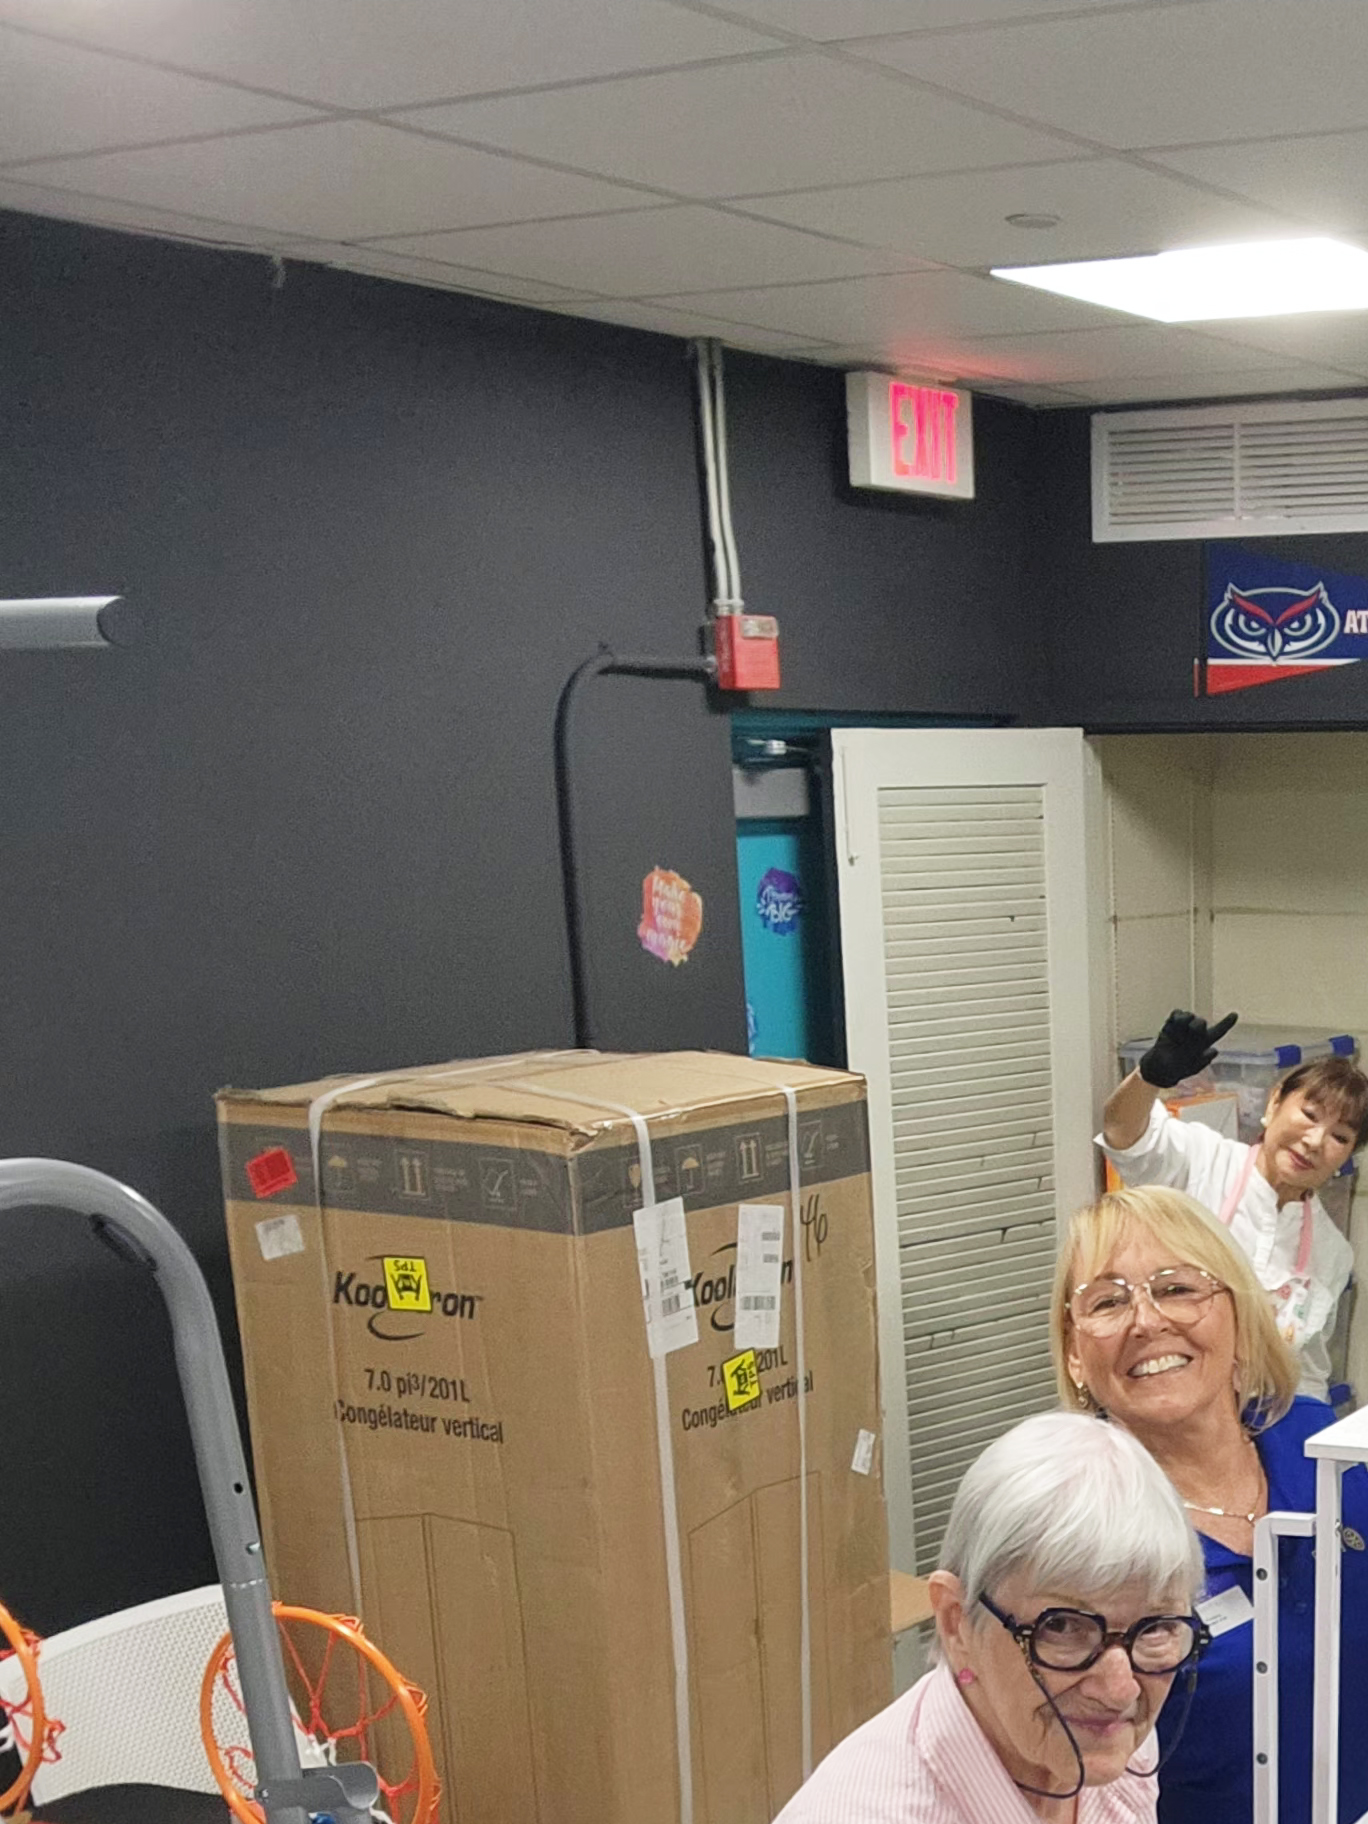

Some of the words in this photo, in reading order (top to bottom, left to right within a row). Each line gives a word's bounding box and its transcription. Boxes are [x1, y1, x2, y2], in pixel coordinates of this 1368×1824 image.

[889, 382, 959, 484] EXIT
[394, 1259, 417, 1273] TPS
[364, 1368, 391, 1393] 7.0
[441, 1416, 504, 1445] vertical
